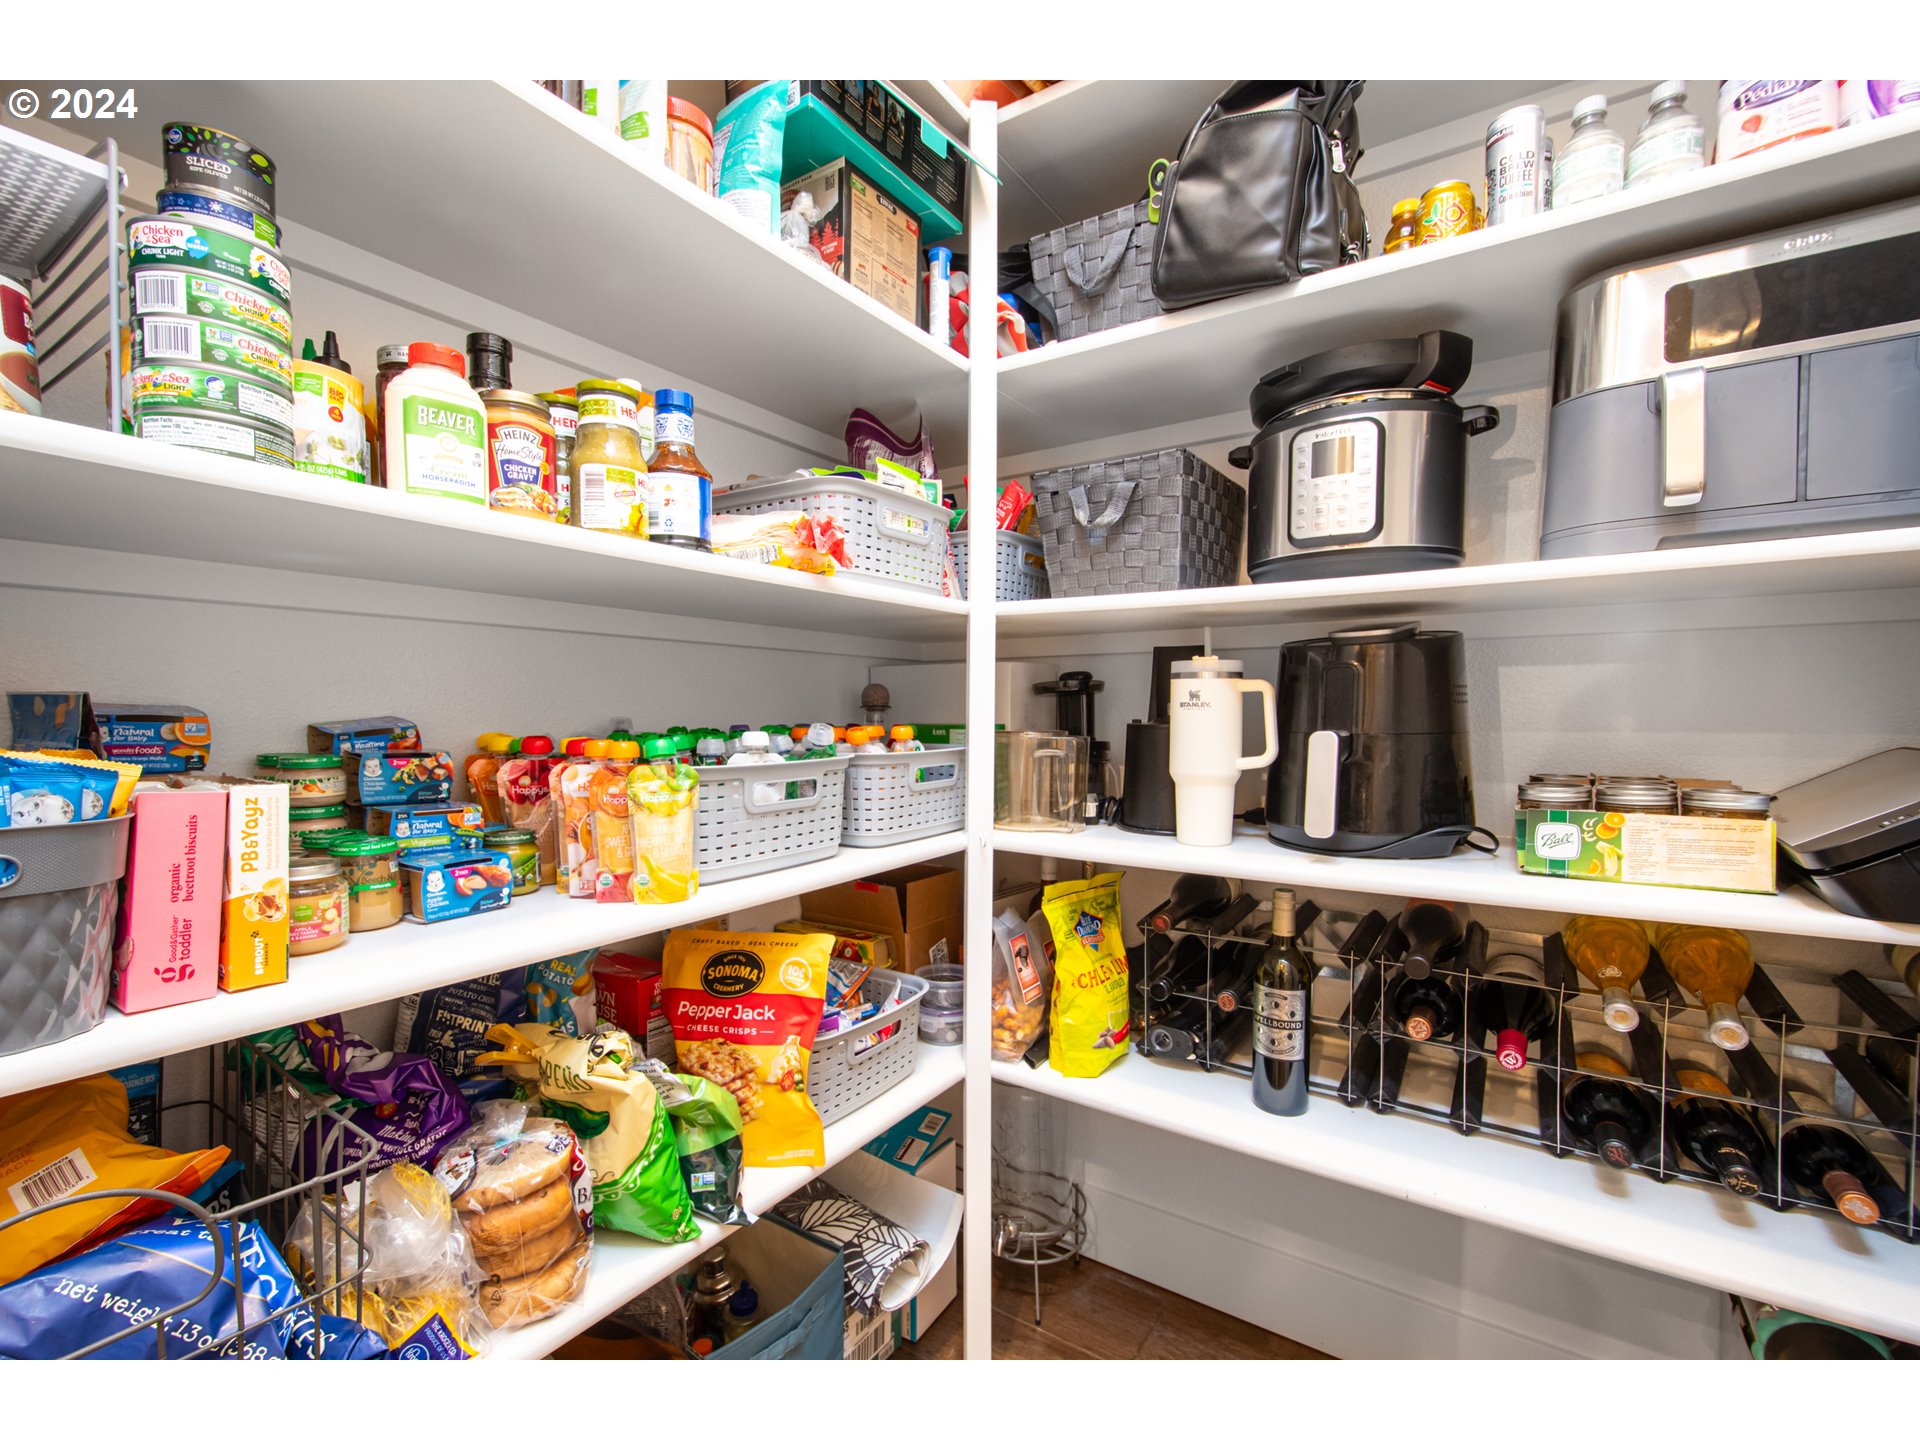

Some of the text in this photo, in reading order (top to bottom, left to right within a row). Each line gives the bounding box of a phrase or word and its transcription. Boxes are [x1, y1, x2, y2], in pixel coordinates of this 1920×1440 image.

[186, 156, 232, 175] SLICED
[204, 168, 229, 179] OLIVES
[142, 225, 183, 237] Chicken
[151, 234, 171, 244] Sea
[142, 248, 184, 257] CHUNK LIGHT
[224, 289, 270, 314] Chicken
[239, 305, 265, 318] CHUNK
[237, 338, 280, 360] Chicken
[251, 352, 274, 365] CHUNK
[168, 372, 189, 384] Sea
[163, 383, 186, 392] LIGHT
[329, 388, 344, 400] BIG
[417, 405, 476, 436] BEAVER
[553, 416, 578, 429] HER
[503, 429, 537, 445] HEINZ
[495, 444, 544, 462] HomeStyle
[503, 463, 537, 476] CHICKEN
[507, 471, 534, 482] GRAVY
[422, 473, 476, 488] HORSERADISH
[482, 783, 499, 793] Hap
[603, 794, 628, 805] Happ
[240, 797, 264, 873] PB&Yayz
[1541, 832, 1574, 850] Ball
[183, 814, 198, 902] beetroot biscuits
[169, 863, 183, 903] organic
[1080, 915, 1092, 925] BLUE
[1077, 920, 1100, 937] DIAMOND
[169, 914, 179, 963] Good&Gather
[179, 918, 192, 961] toddler
[254, 937, 264, 975] SPROUT
[551, 959, 577, 977] REAL
[1112, 955, 1129, 975] LIM
[538, 963, 574, 986] POTATO
[707, 965, 758, 981] SONOMA
[448, 987, 477, 1000] POTATO
[713, 982, 745, 992] CREAMERY
[677, 1001, 776, 1021] Pepper Jack
[687, 1024, 757, 1036] CHEESE CRISPS
[124, 1074, 156, 1089] ORNERS
[376, 1124, 417, 1147] Making
[21, 1171, 41, 1185] ITEM
[53, 1277, 98, 1304] net
[171, 1319, 202, 1343] 13
[431, 1320, 440, 1330] THE
